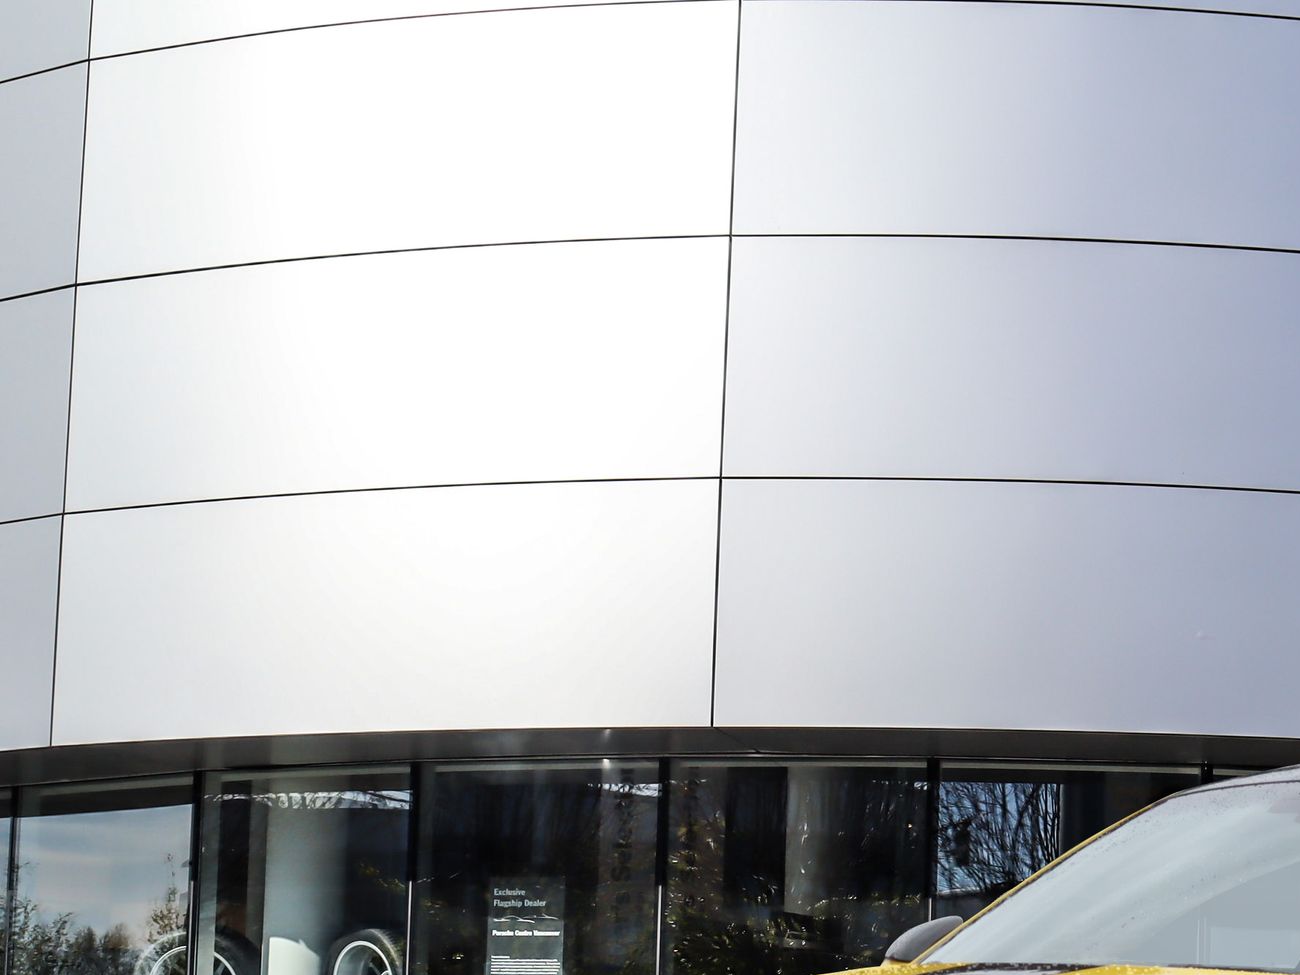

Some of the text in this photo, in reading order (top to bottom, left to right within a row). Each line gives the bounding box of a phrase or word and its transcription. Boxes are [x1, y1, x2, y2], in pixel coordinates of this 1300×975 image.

[493, 888, 526, 896] Exclusive
[493, 899, 547, 908] Flagship Dealer
